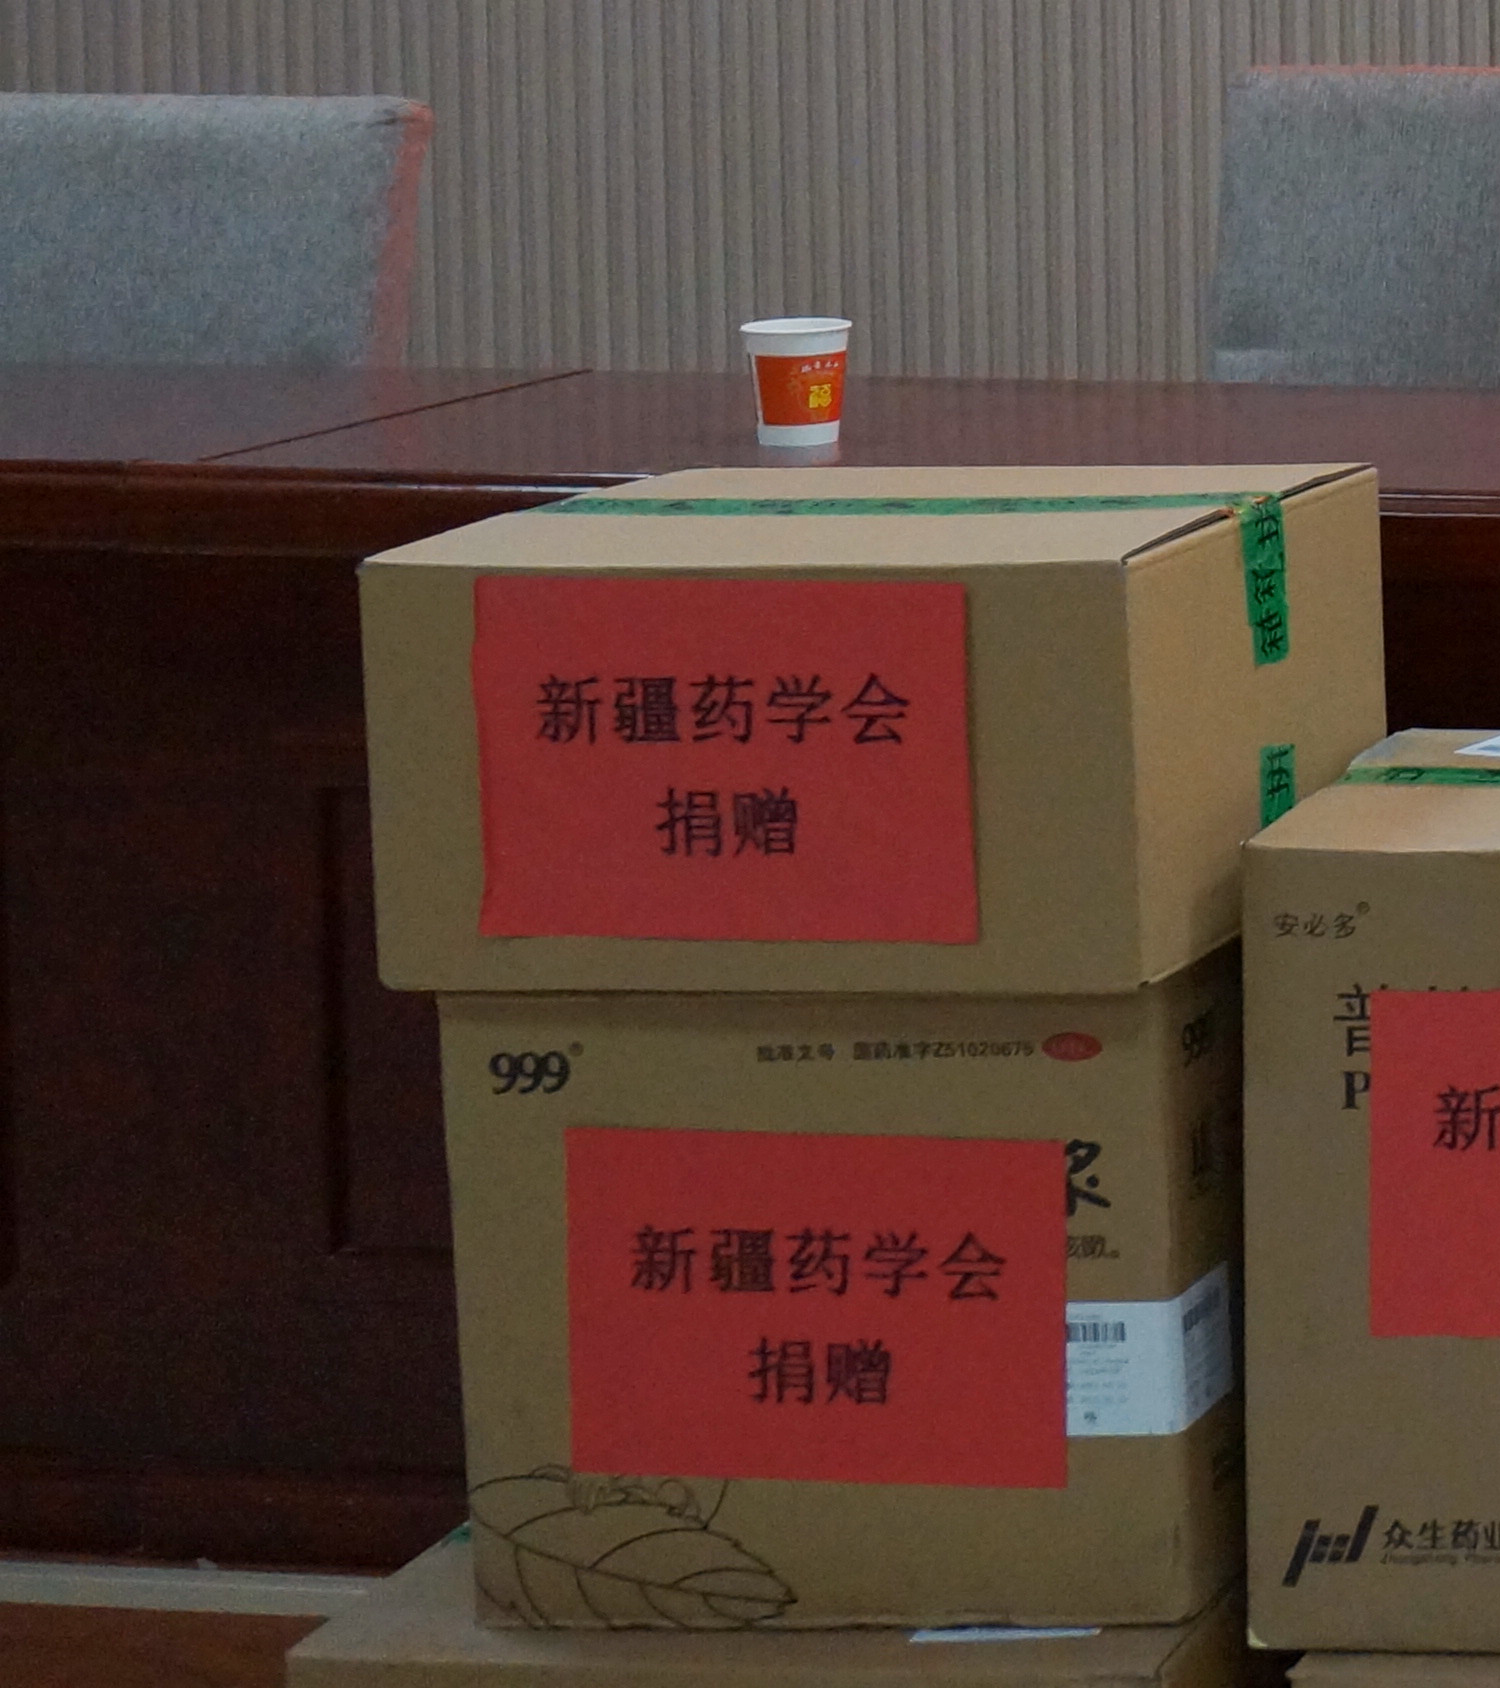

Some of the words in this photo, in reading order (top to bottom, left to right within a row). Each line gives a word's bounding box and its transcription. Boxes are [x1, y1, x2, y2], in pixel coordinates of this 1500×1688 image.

[536, 673, 910, 745] 新疆药学会
[655, 787, 798, 858] 捐赠
[489, 1050, 570, 1095] 999
[631, 1224, 1006, 1301] 新疆药学会
[748, 1337, 892, 1405] 捐赠
